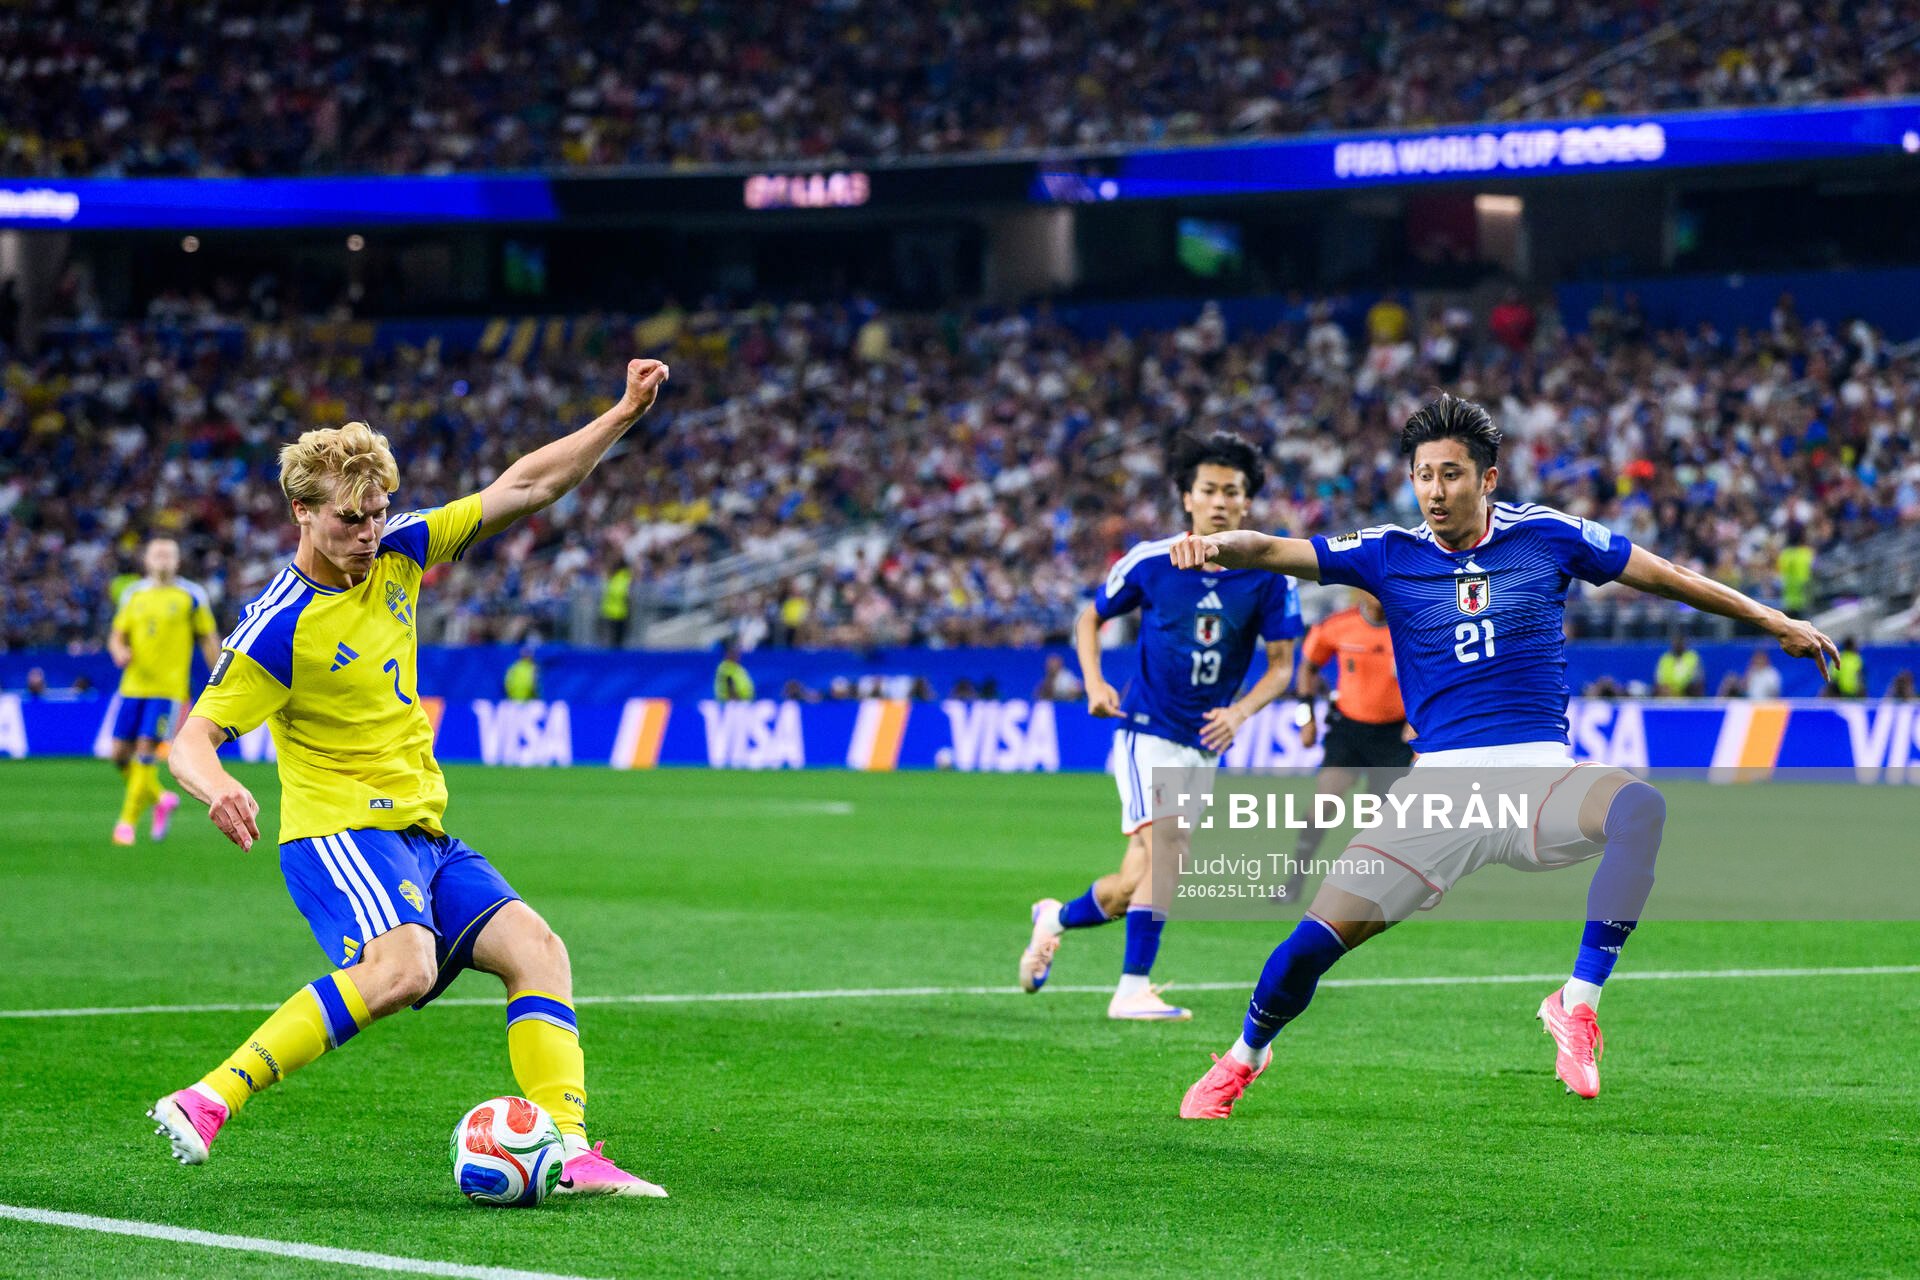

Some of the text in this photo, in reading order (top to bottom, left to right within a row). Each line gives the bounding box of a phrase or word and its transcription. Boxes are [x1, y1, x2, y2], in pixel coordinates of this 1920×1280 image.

[1334, 140, 1397, 178] FIFA
[1398, 134, 1500, 174] WORLD
[1500, 130, 1558, 169] CUP
[1191, 650, 1222, 687] 13
[1454, 618, 1495, 663] 21
[383, 658, 412, 704] 2
[472, 699, 572, 766] VISA
[698, 699, 806, 768] VISA
[941, 698, 1060, 772] VISA
[1565, 700, 1650, 778] SA
